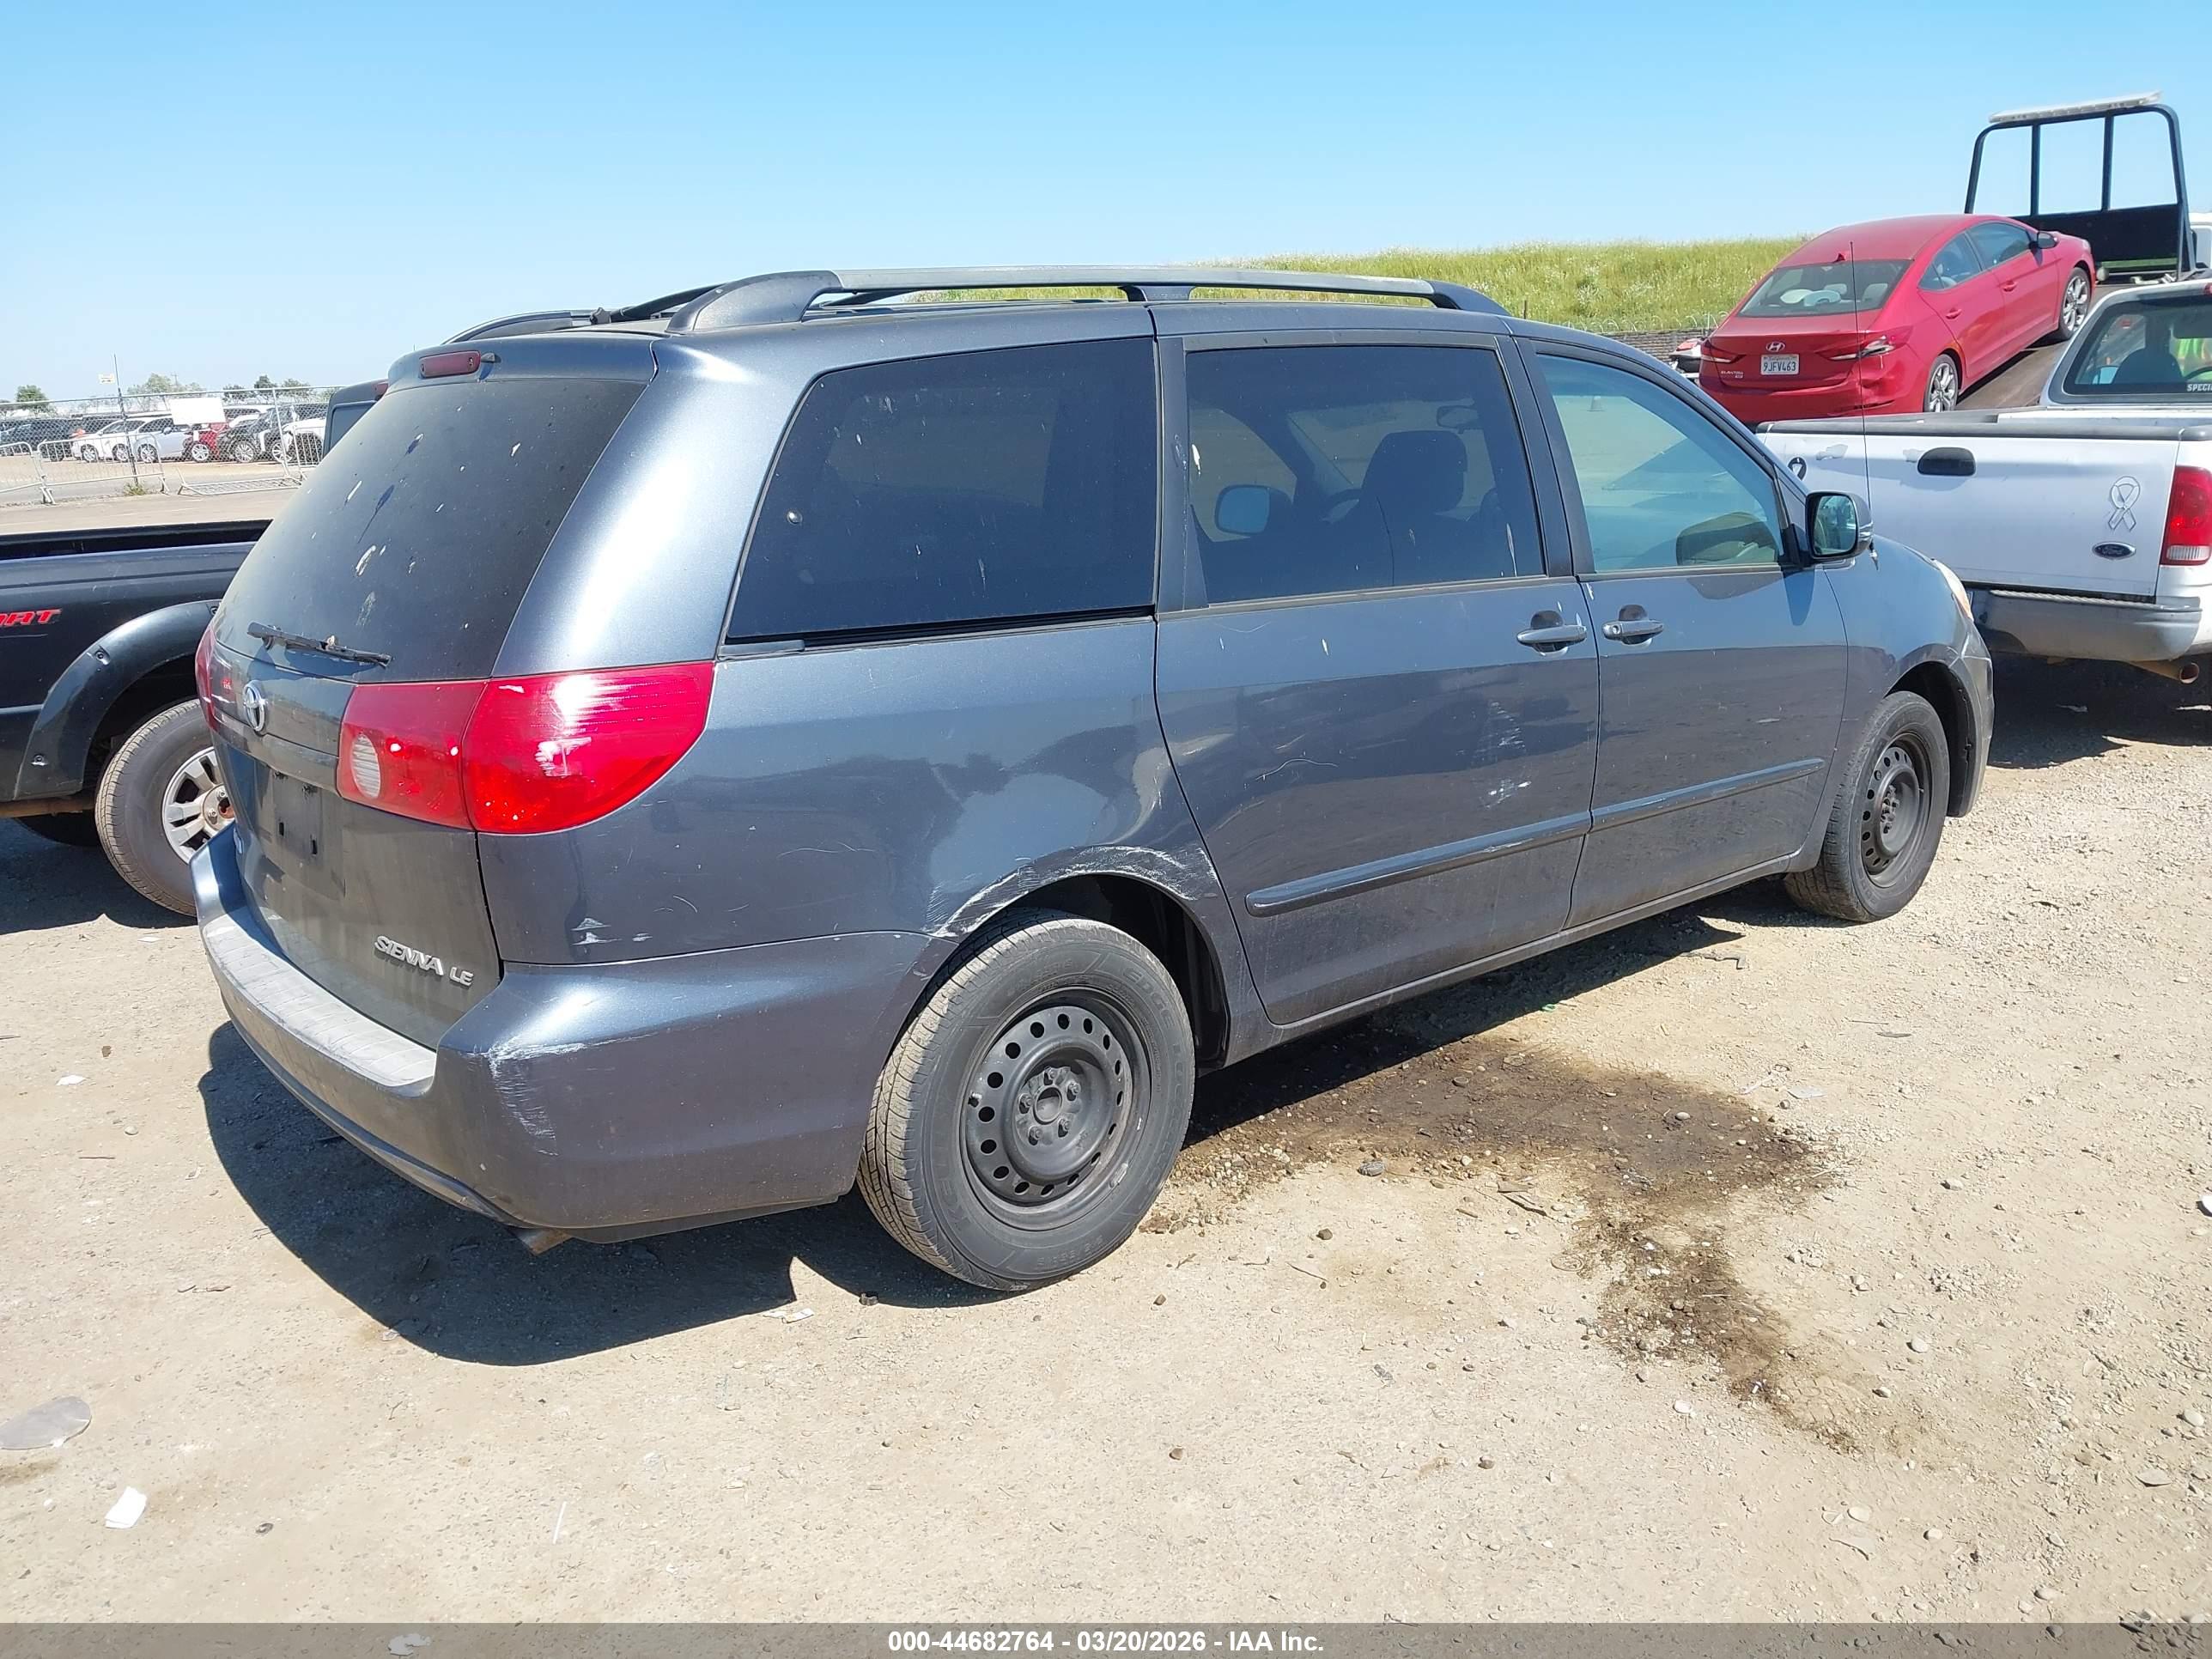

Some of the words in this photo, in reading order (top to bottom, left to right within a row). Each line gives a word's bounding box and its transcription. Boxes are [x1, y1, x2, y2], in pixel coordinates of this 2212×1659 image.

[1763, 362, 1796, 372] 9JFV463
[374, 935, 444, 975] SIENNA
[449, 967, 474, 987] LE
